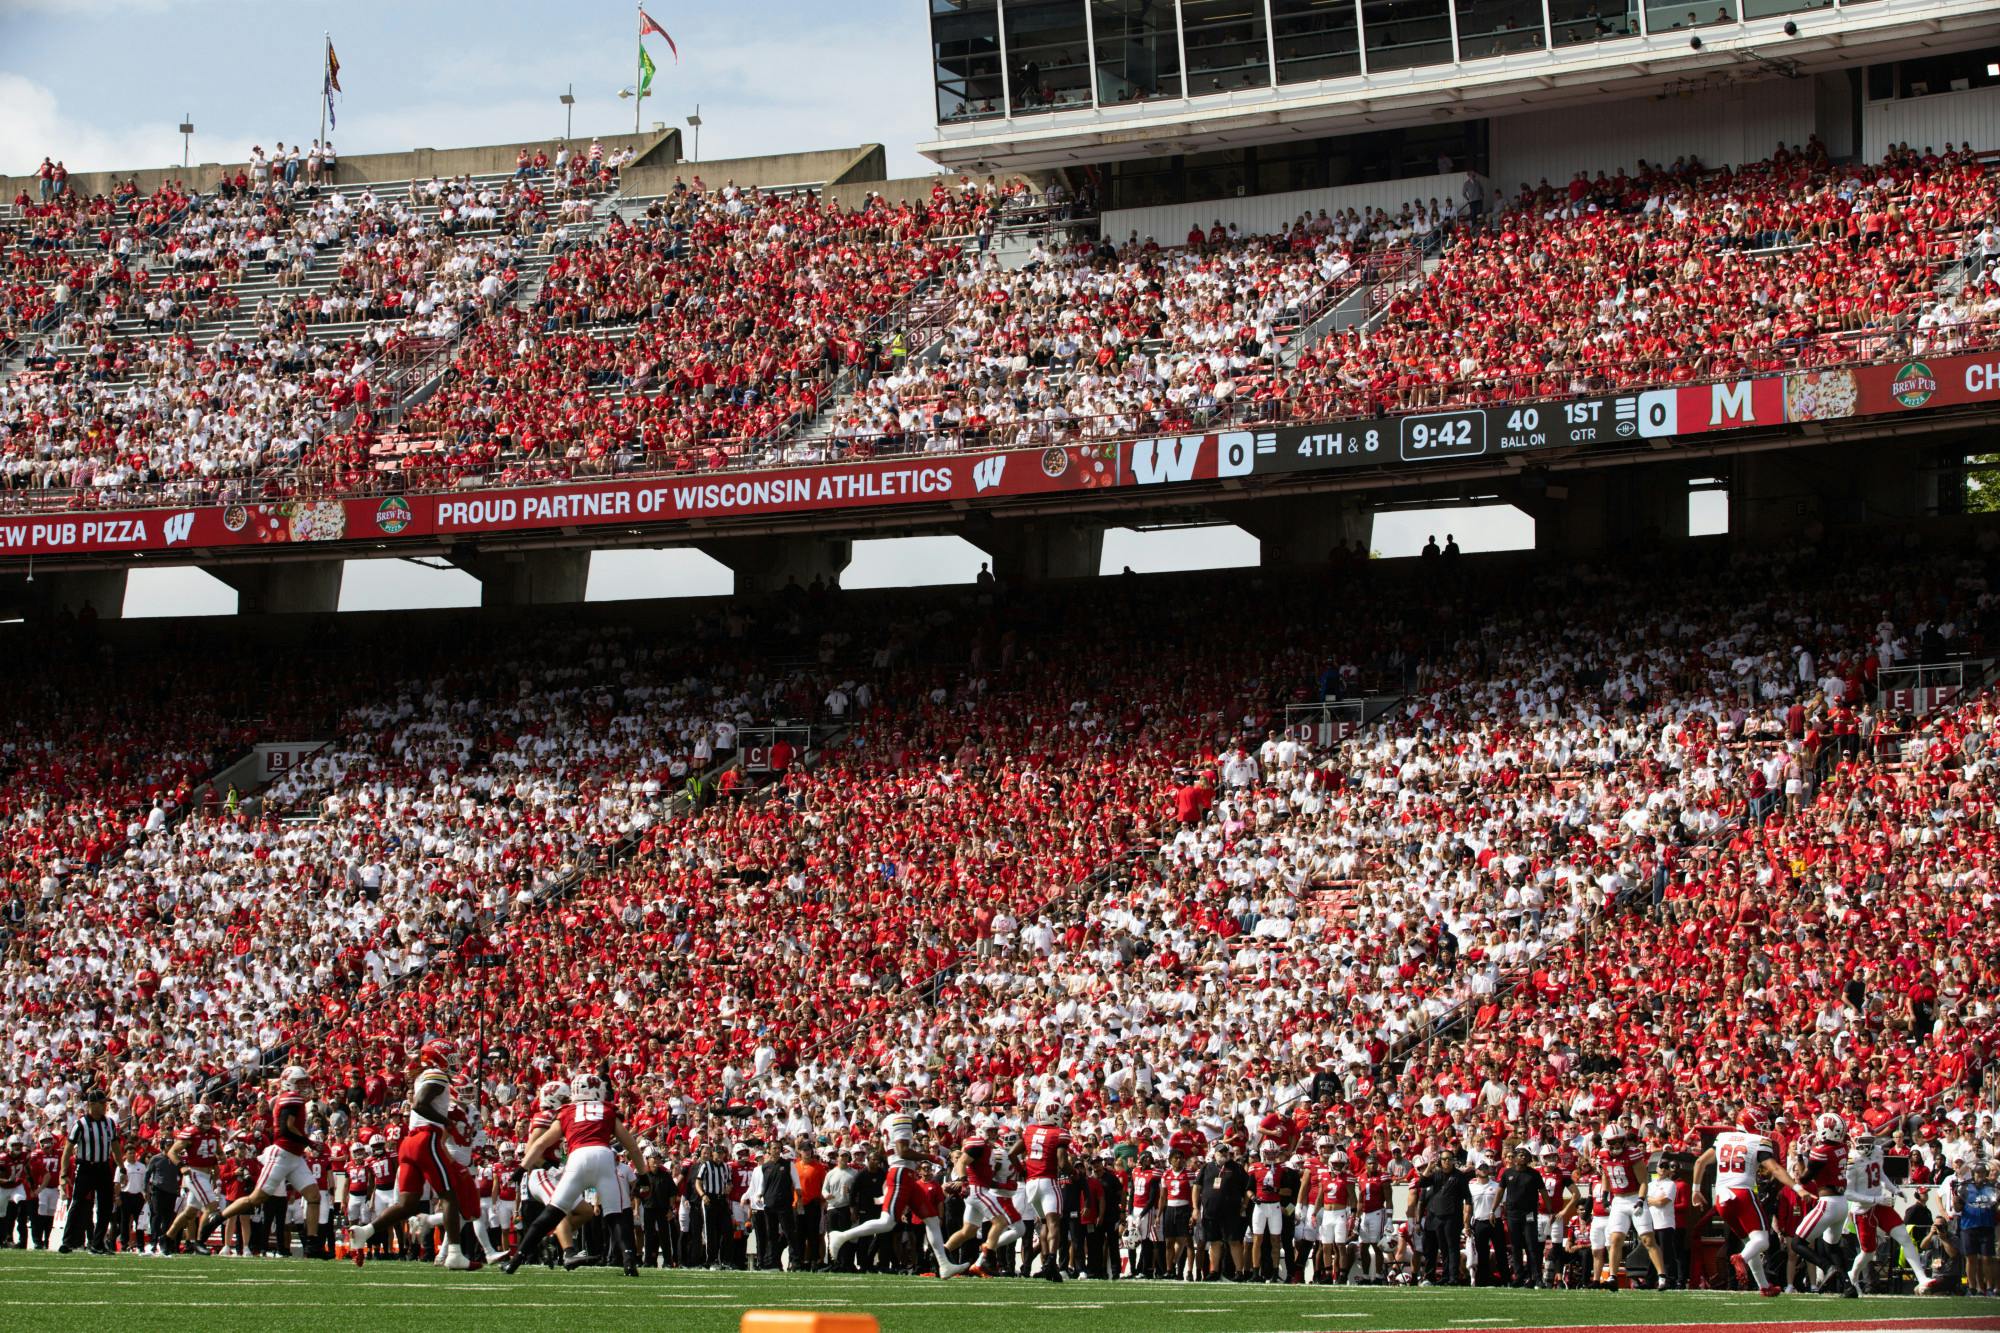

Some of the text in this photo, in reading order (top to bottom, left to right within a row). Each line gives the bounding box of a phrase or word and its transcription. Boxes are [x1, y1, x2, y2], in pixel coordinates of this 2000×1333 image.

[1892, 377, 1936, 396] BREW PUB
[1708, 380, 1756, 426] M
[1904, 395, 1926, 405] PIZZA
[1506, 408, 1539, 432] 40
[1564, 401, 1603, 425] 1ST
[1648, 402, 1667, 427] 0
[1297, 429, 1379, 457] 4TH & 8
[1412, 419, 1472, 449] 9:42
[1501, 433, 1546, 449] BALL ON
[1570, 427, 1596, 442] QTR
[1131, 435, 1205, 485] W
[1228, 443, 1244, 466] 0
[972, 455, 1006, 493] W
[438, 467, 953, 525] PROUD PARTNER OF WISCONSIN ATHLETICS
[376, 508, 412, 523] BREW PUB
[31, 523, 76, 546] PUB
[82, 520, 147, 544] PIZZA
[163, 512, 195, 546] W
[1894, 690, 1906, 707] E
[1935, 687, 1947, 705] F
[1301, 724, 1312, 741] D
[1338, 722, 1350, 738] E
[273, 752, 283, 767] B
[751, 747, 761, 763] C
[574, 1102, 604, 1123] 19
[386, 1127, 401, 1140] 33
[1030, 1134, 1046, 1160] 5
[43, 1158, 59, 1172] 77
[1718, 1144, 1748, 1173] 96
[1865, 1162, 1881, 1188] 13
[1170, 1180, 1180, 1196] 3
[1327, 1183, 1338, 1199] 2
[1365, 1183, 1370, 1201] 1
